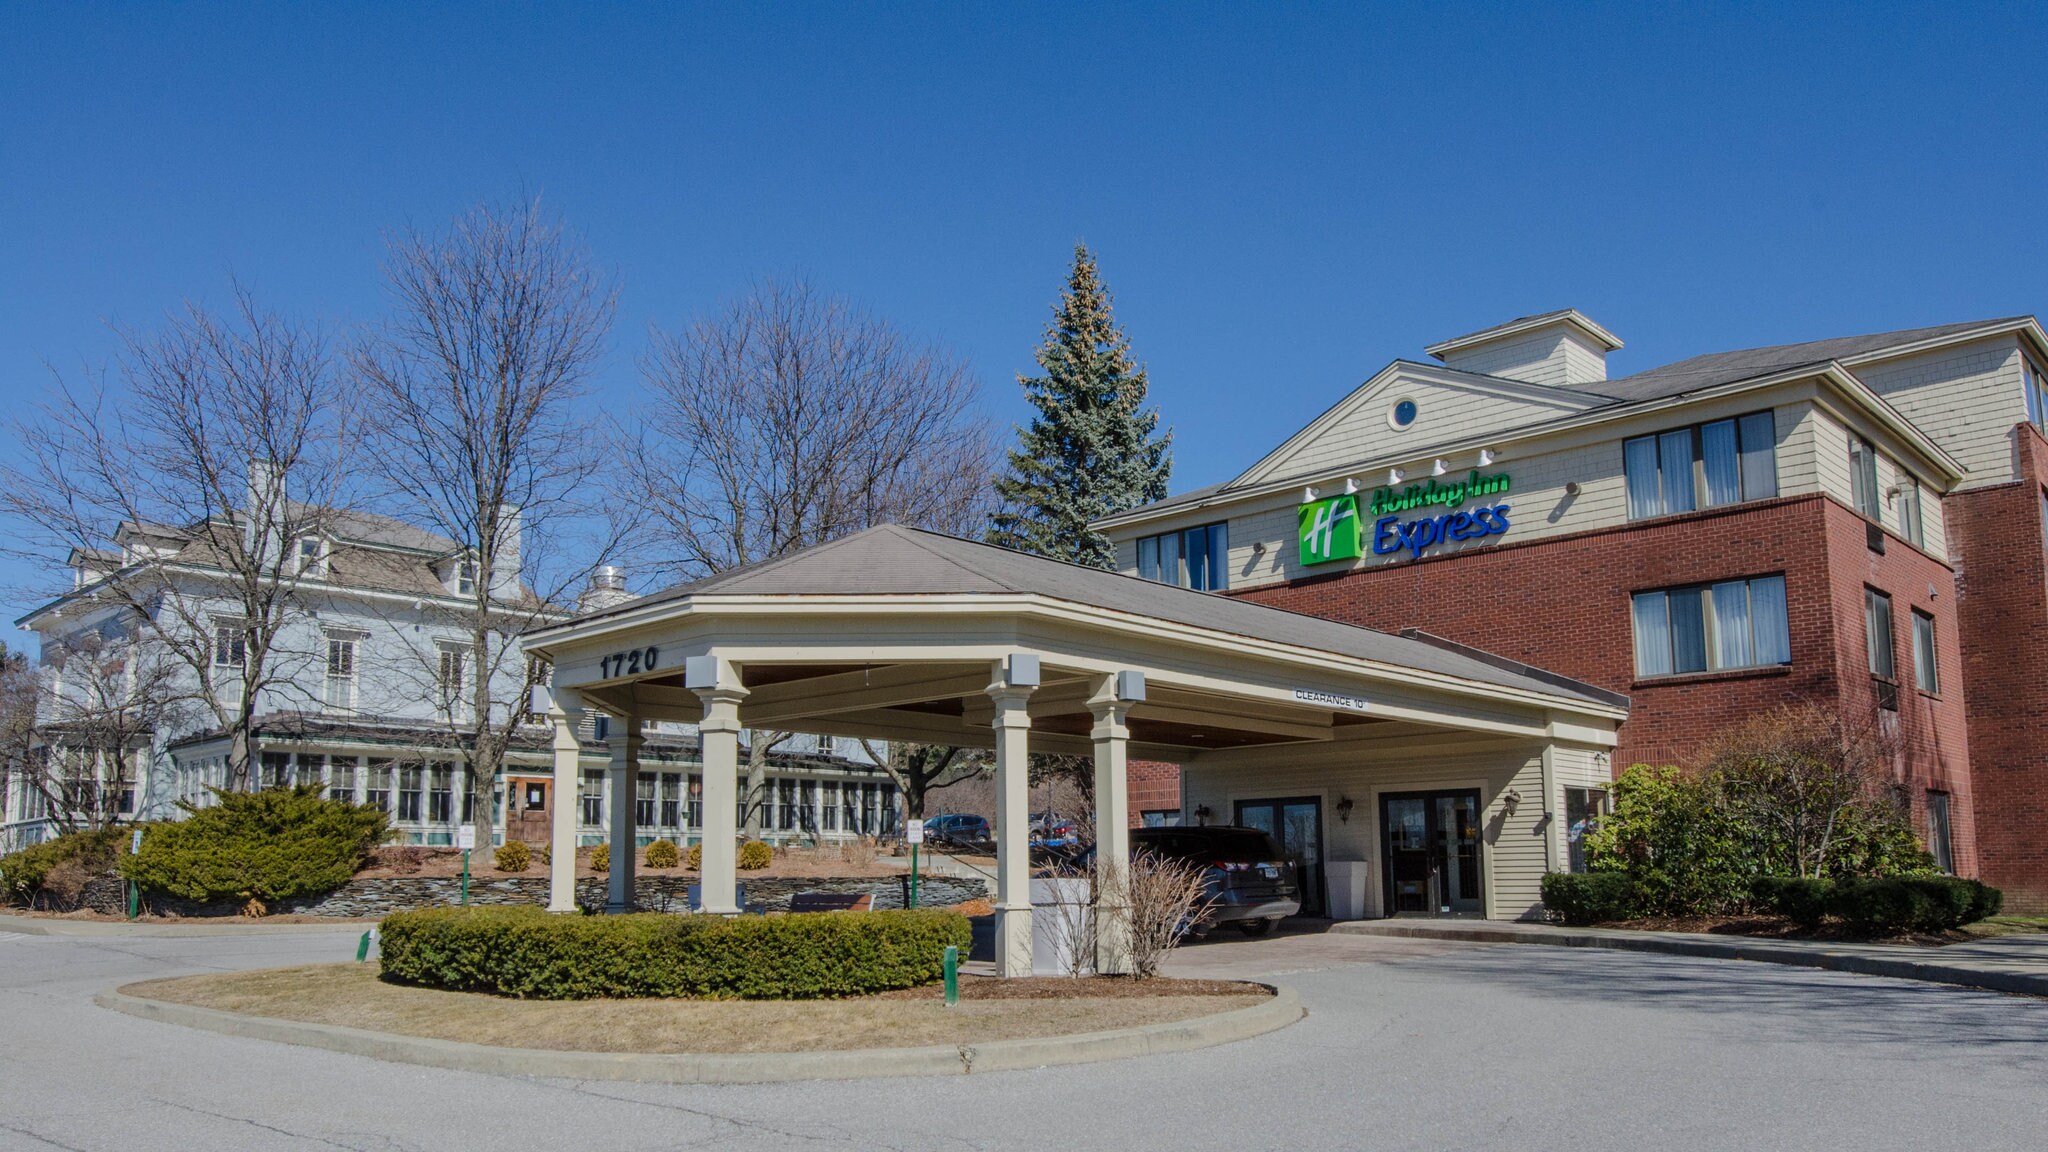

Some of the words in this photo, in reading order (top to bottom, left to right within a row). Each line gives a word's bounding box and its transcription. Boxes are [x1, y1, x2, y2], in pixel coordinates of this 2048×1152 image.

[1370, 479, 1466, 515] Holiday
[1467, 470, 1510, 497] Inn
[1373, 504, 1511, 558] Express
[600, 646, 658, 679] 1720
[1295, 689, 1351, 707] CLEARANCE
